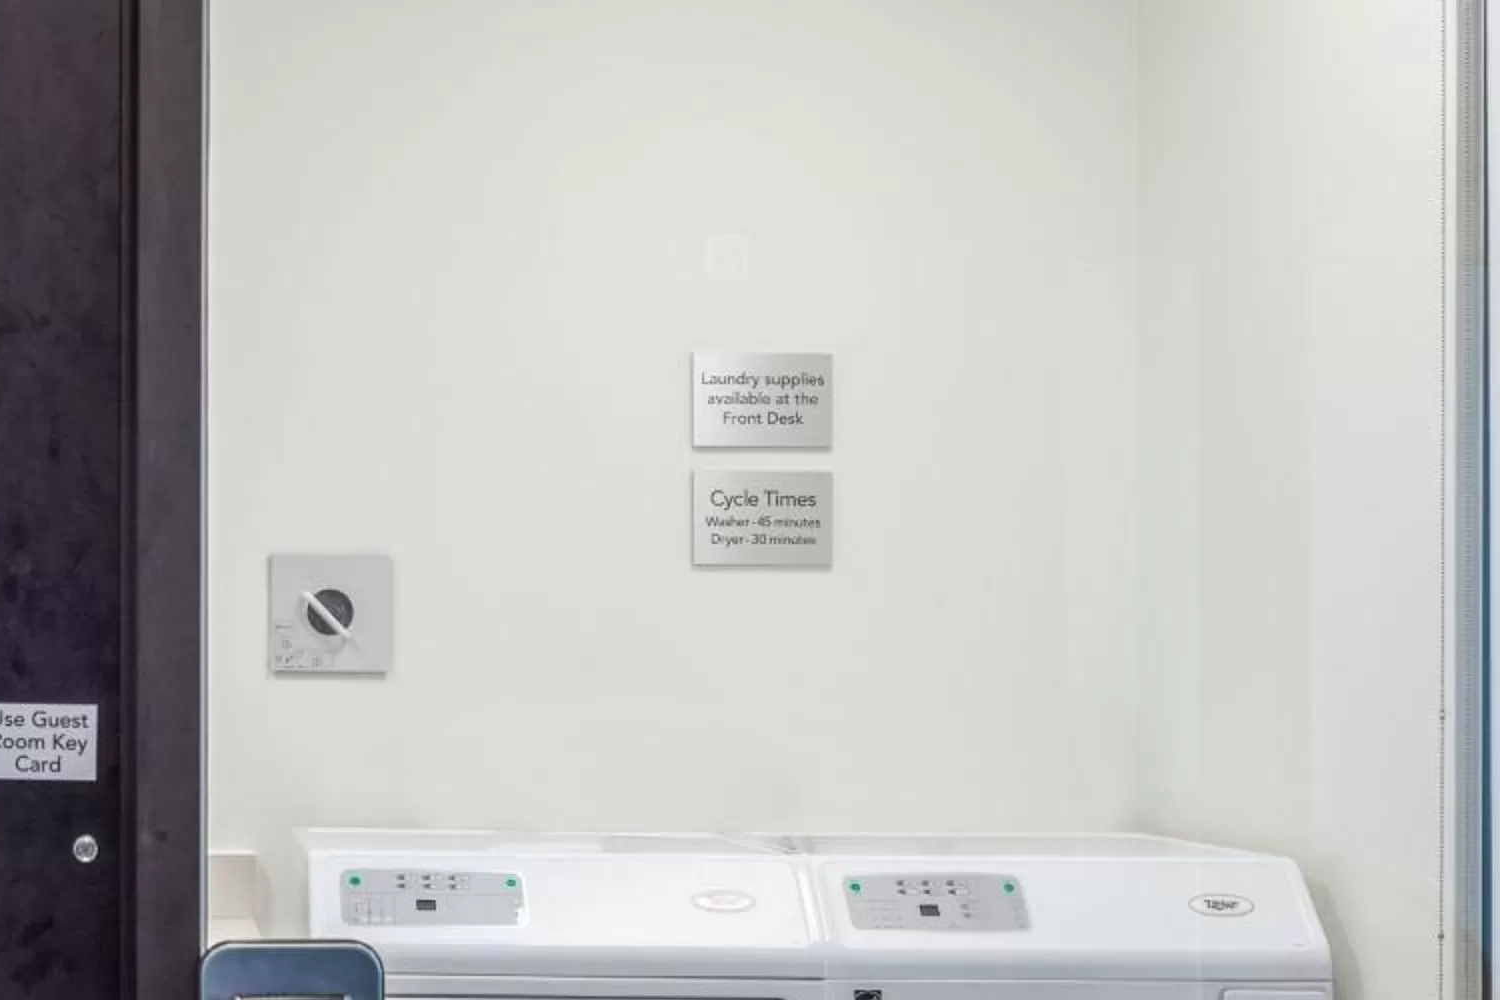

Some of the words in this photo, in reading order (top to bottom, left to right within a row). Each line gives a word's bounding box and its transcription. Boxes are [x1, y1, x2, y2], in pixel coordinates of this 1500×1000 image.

[701, 371, 760, 389] Laundry
[765, 371, 826, 390] supplies
[707, 391, 771, 405] available
[775, 393, 790, 405] at
[795, 391, 819, 405] the
[723, 411, 763, 425] Front
[767, 411, 805, 425] Desk
[710, 488, 759, 511] Cycle
[764, 488, 817, 508] Times
[774, 516, 821, 528] minutes
[769, 534, 817, 545] minutes
[31, 709, 90, 729] Guest
[52, 732, 88, 756] Key
[15, 754, 62, 773] Card
